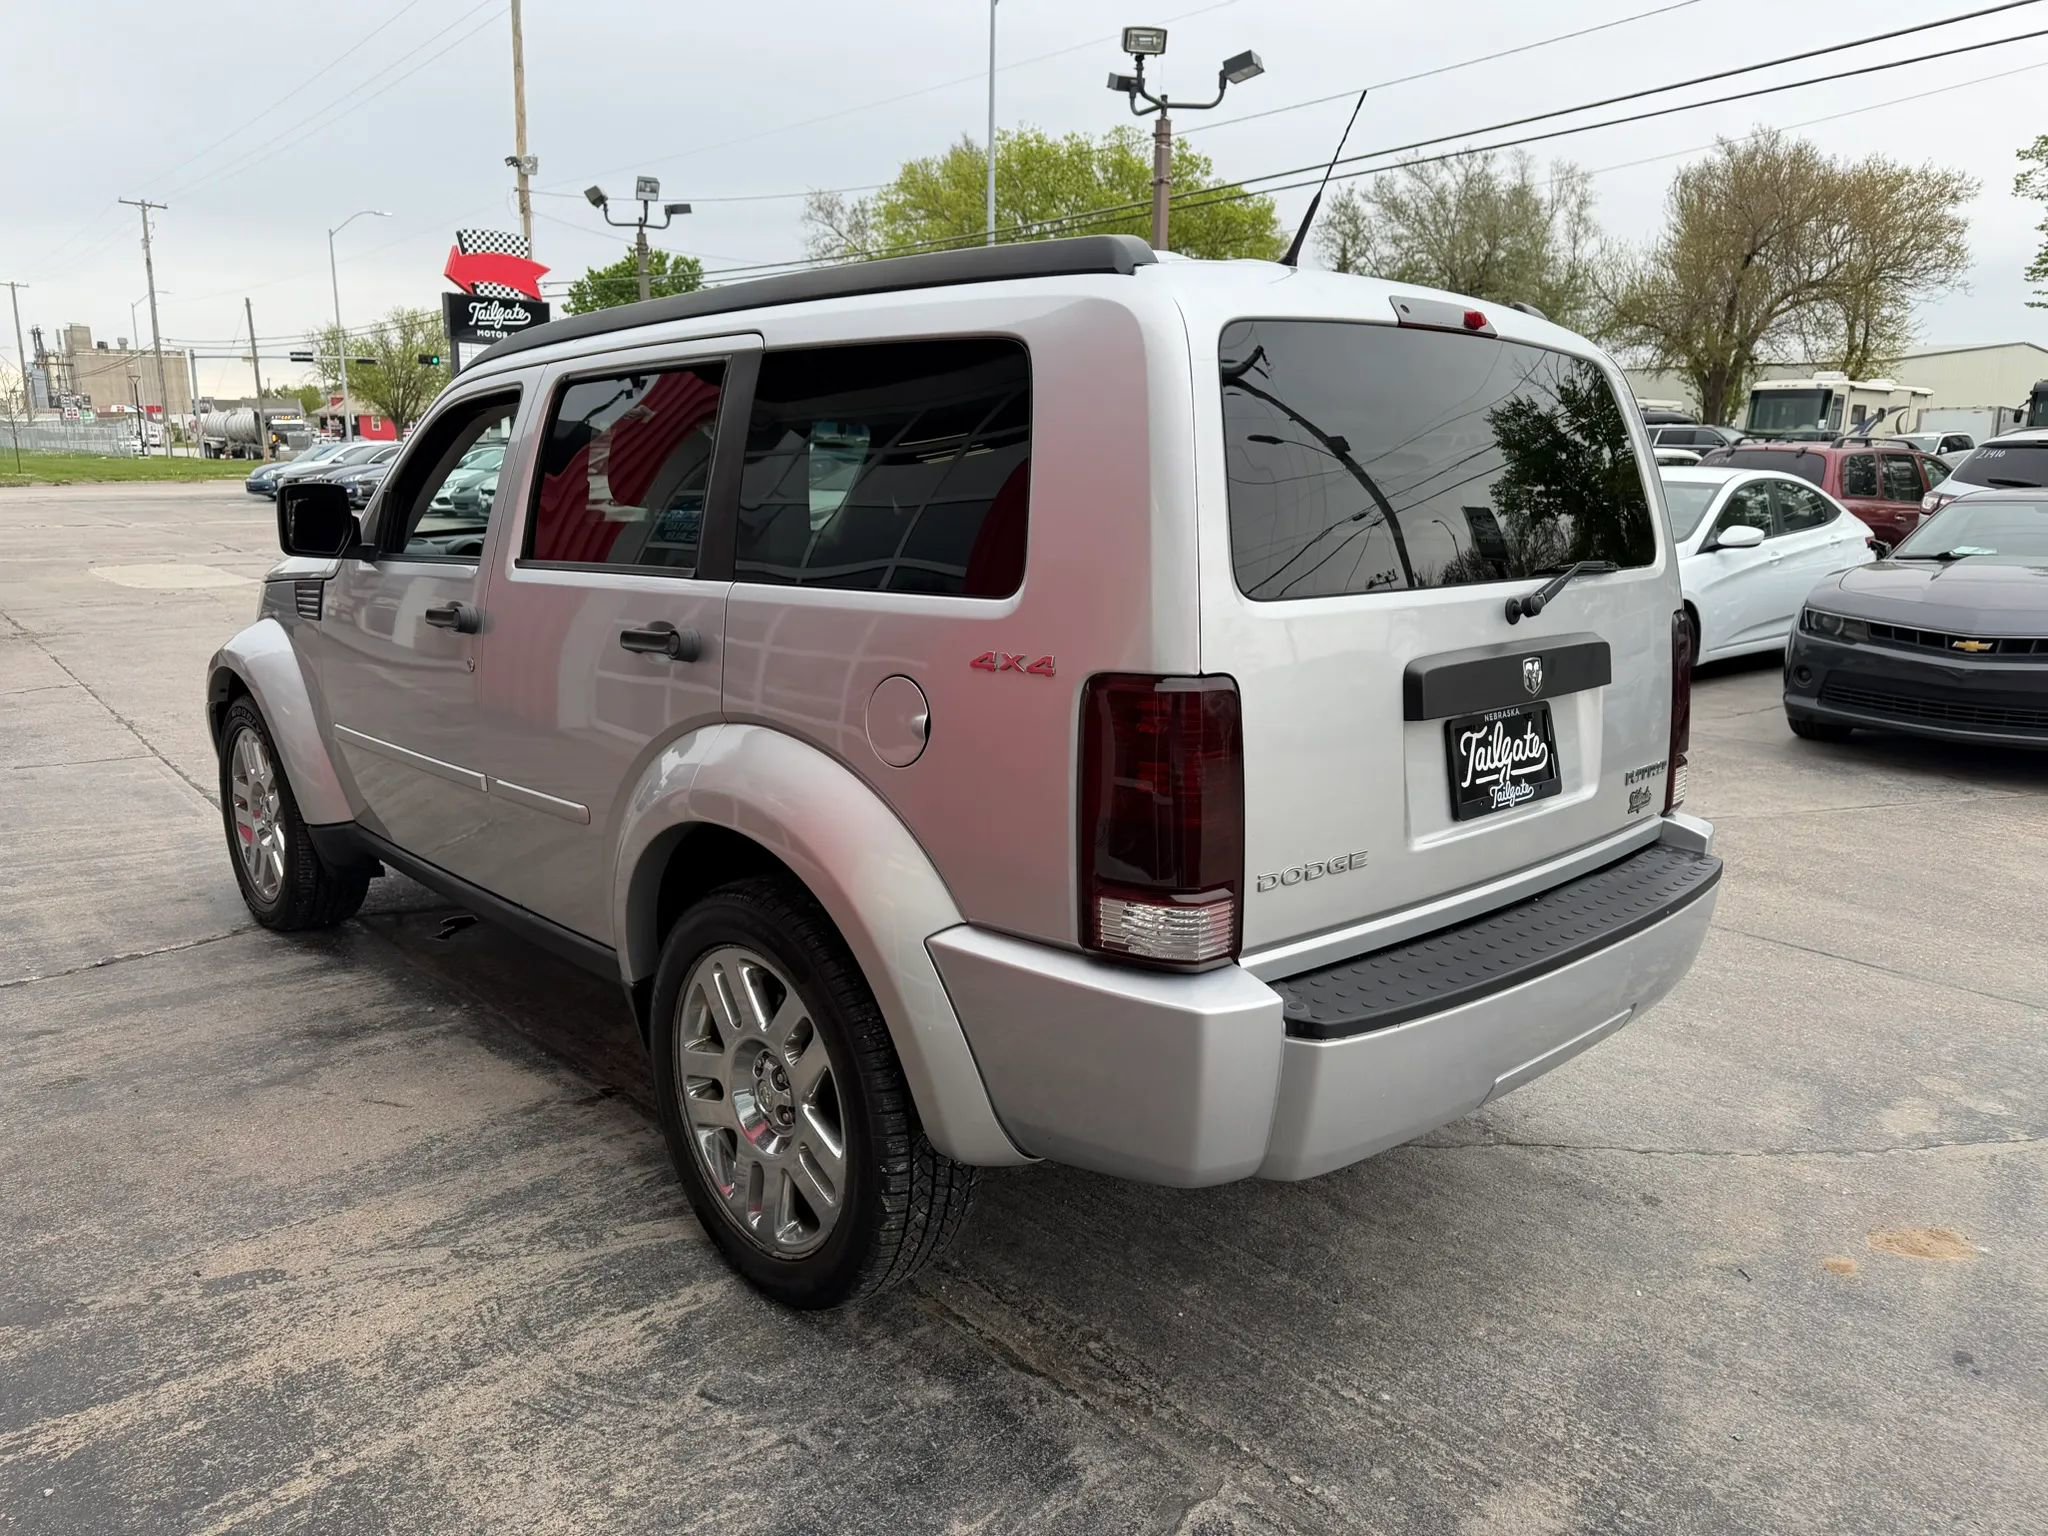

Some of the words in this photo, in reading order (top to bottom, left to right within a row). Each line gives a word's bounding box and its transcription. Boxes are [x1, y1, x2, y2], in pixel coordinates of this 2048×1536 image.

[468, 300, 531, 329] Tailgate
[477, 329, 508, 338] MOTOR
[1484, 707, 1520, 722] NEBRASKA
[1460, 720, 1548, 788] Tailgate
[1489, 779, 1534, 809] Tailgate
[1257, 848, 1368, 893] DODGE
